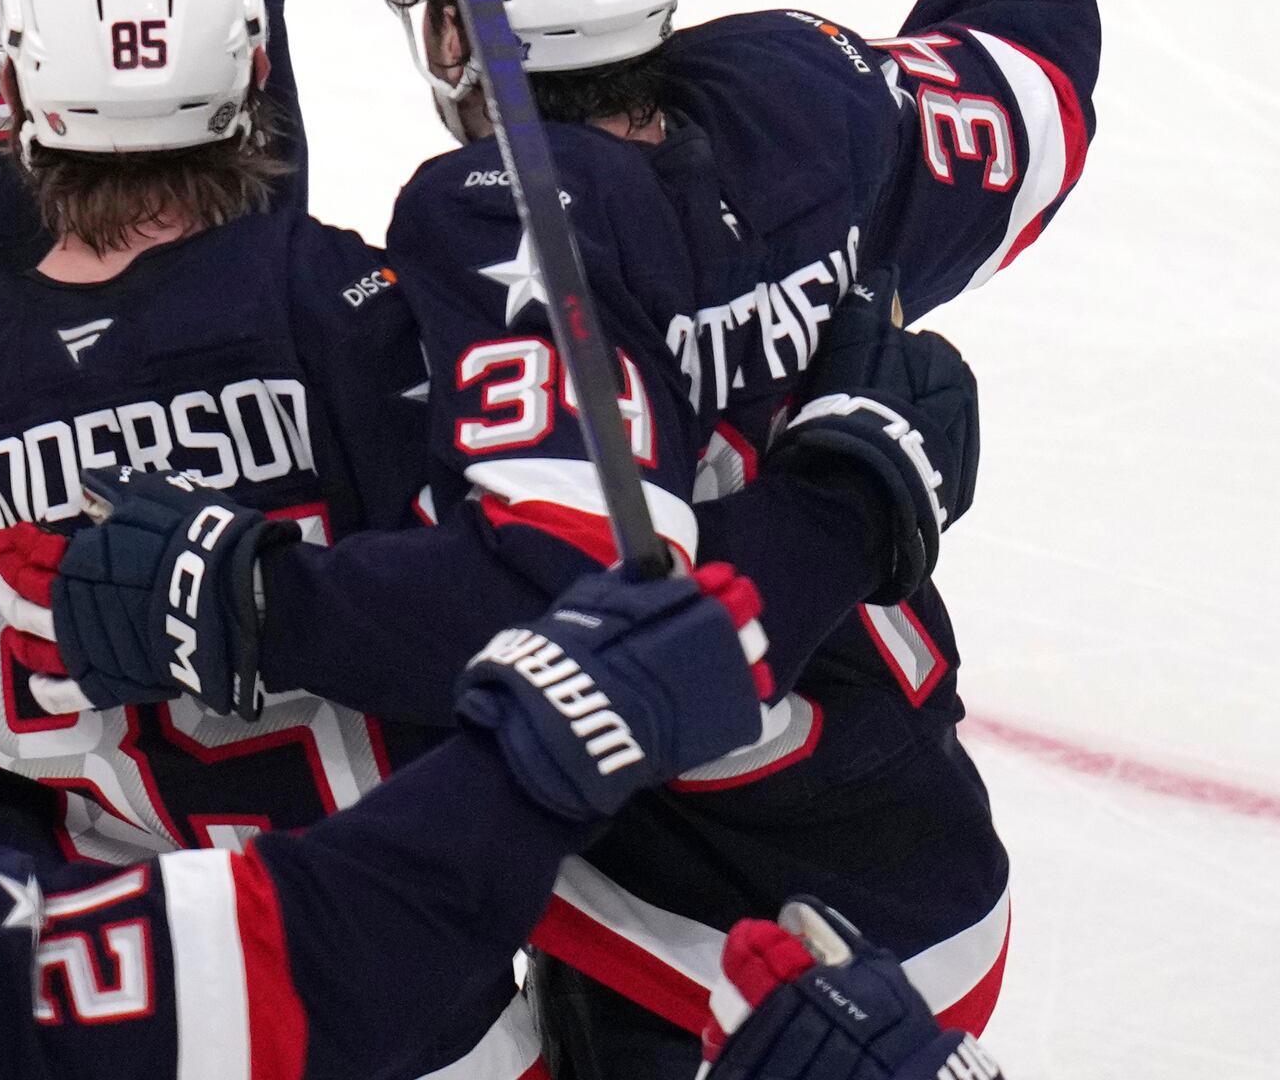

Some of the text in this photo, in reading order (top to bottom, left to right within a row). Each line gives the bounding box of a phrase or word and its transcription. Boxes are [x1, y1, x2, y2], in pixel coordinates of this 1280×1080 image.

[111, 20, 168, 70] 85
[865, 31, 1019, 193] 34
[165, 504, 236, 694] CCM
